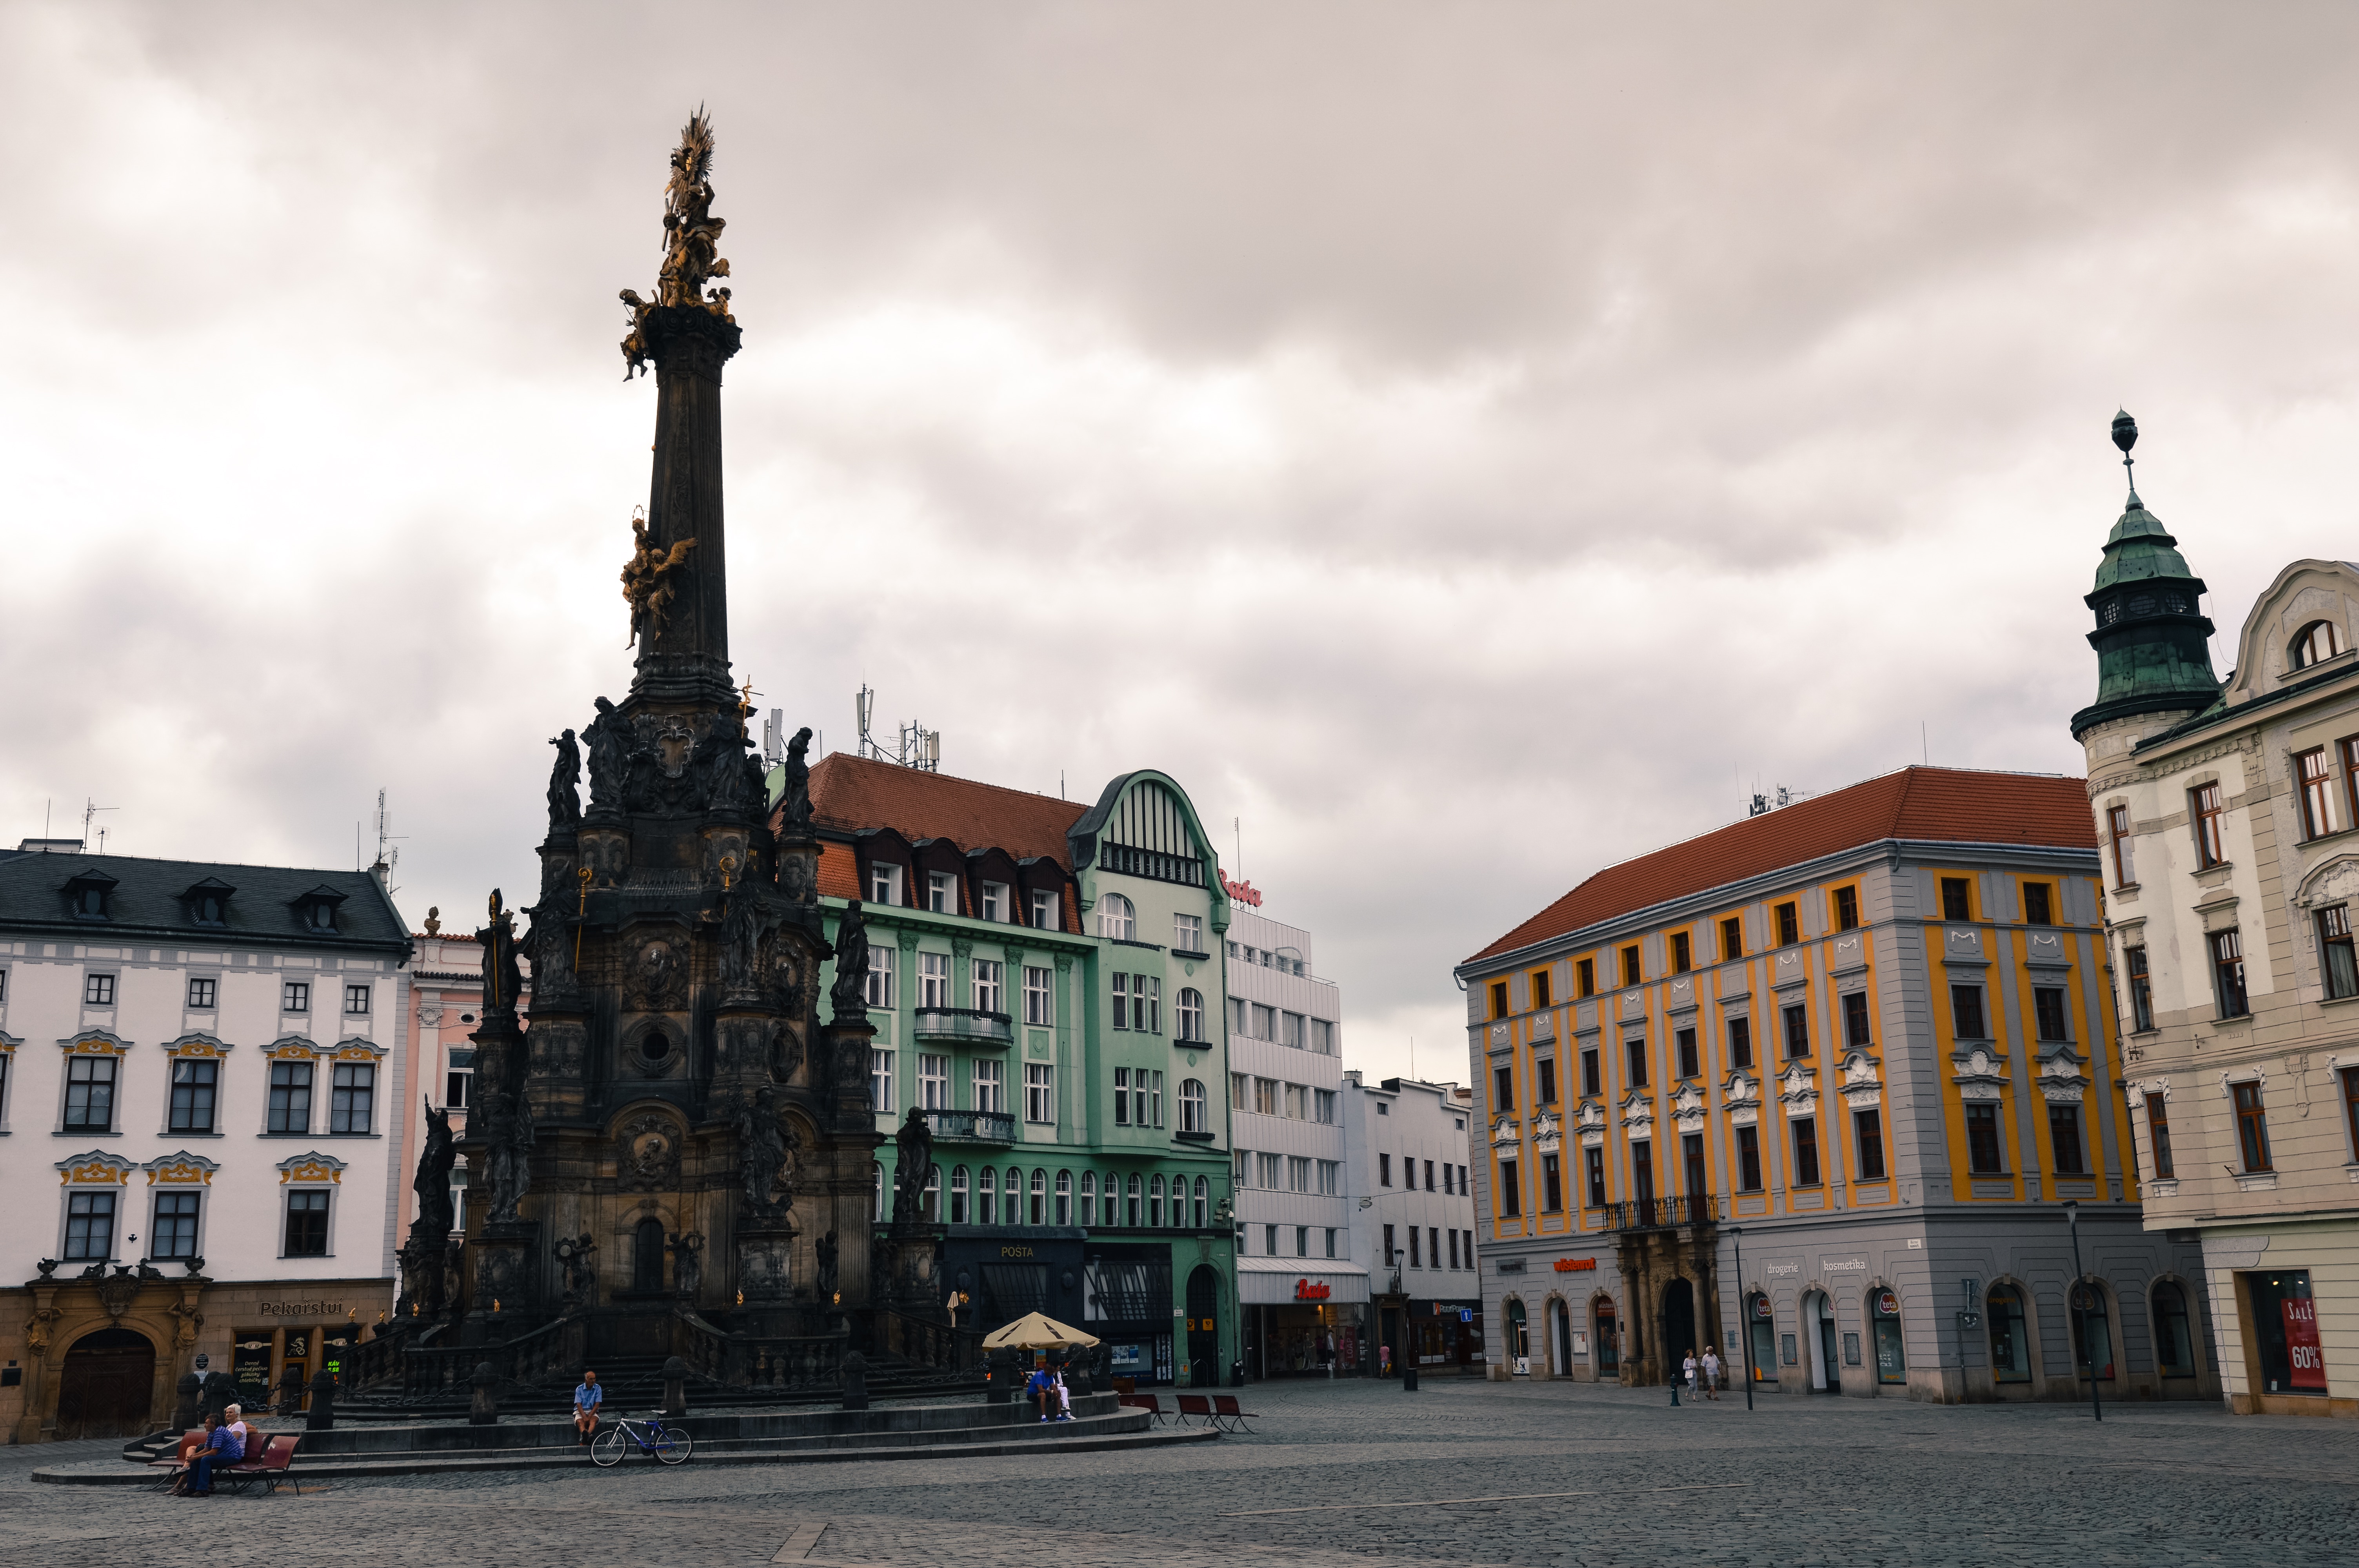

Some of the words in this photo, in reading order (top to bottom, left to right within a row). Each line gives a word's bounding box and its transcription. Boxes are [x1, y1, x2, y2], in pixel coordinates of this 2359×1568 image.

[1001, 1244, 1033, 1257] POŠTA
[1553, 1257, 1596, 1272] wüstenrot
[1767, 1263, 1799, 1276] drogerie
[1824, 1259, 1866, 1271] kosmetika
[1296, 1279, 1331, 1299] Bata
[260, 1297, 343, 1316] Pekařství
[1988, 1296, 2016, 1305] drogerie
[2288, 1301, 2313, 1320] SALE
[2292, 1346, 2320, 1368] 60%
